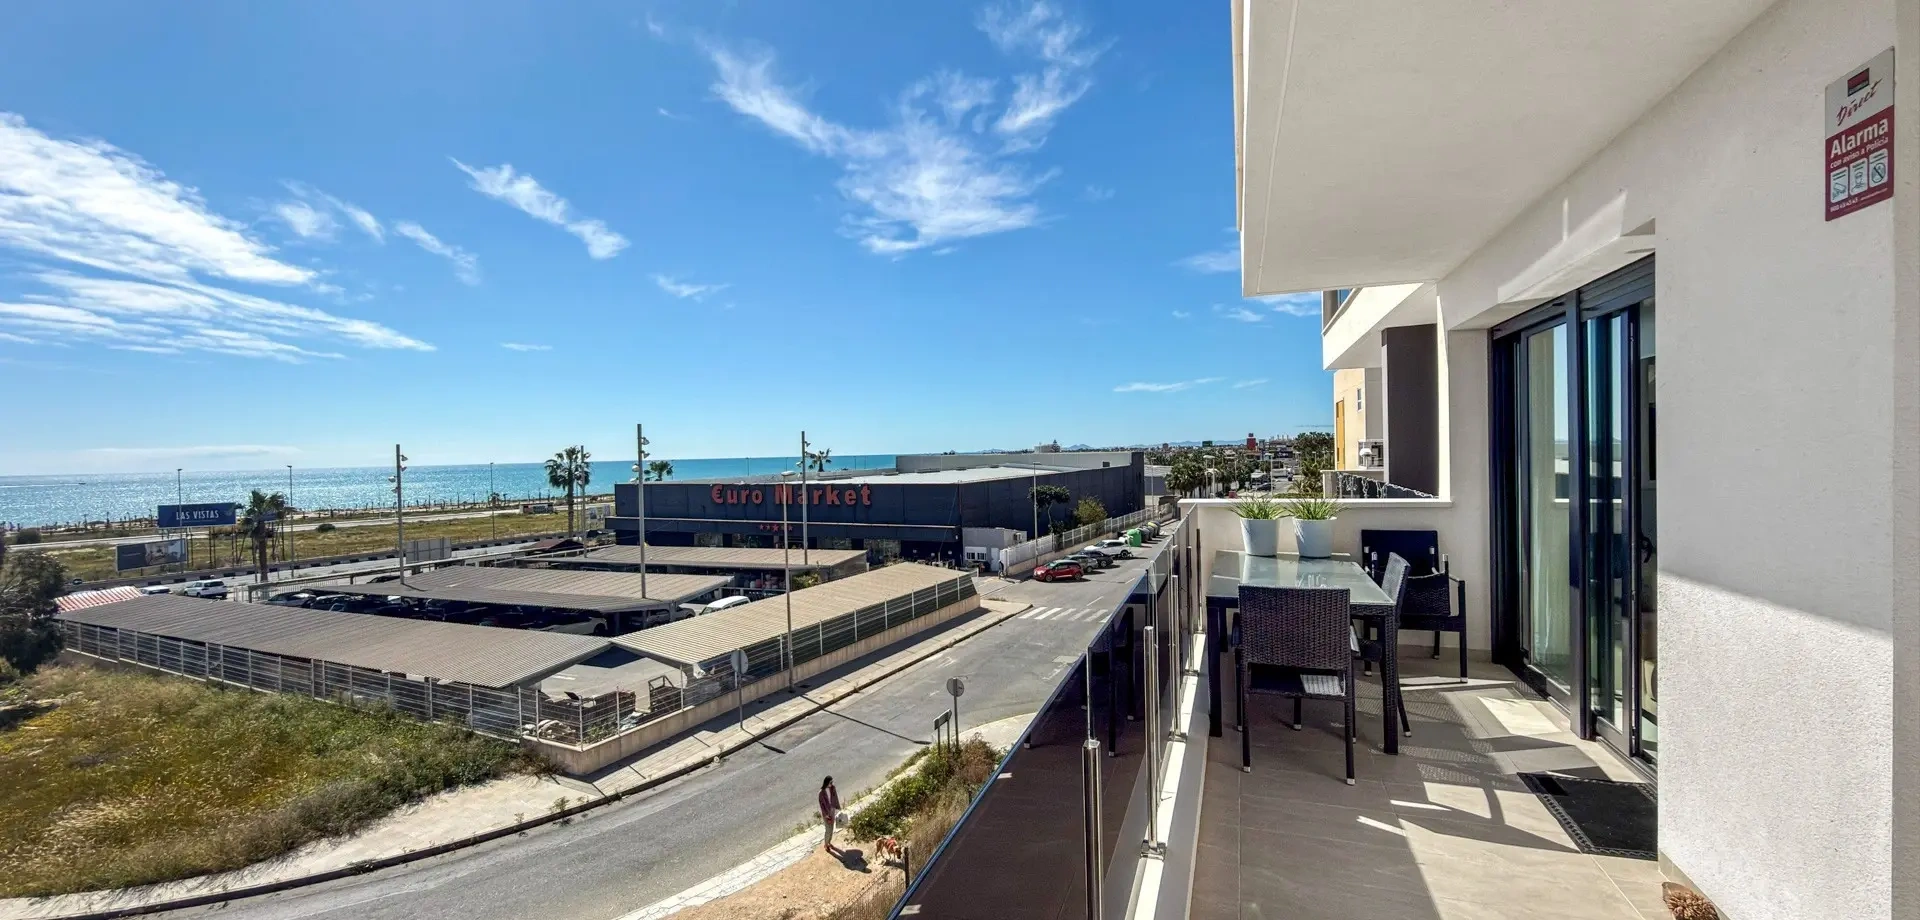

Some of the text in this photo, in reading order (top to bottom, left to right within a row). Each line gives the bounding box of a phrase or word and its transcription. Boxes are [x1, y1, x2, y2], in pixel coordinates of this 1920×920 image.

[1830, 118, 1889, 159] Alarma
[774, 484, 872, 506] Market
[176, 510, 219, 520] LAS VISTAS
